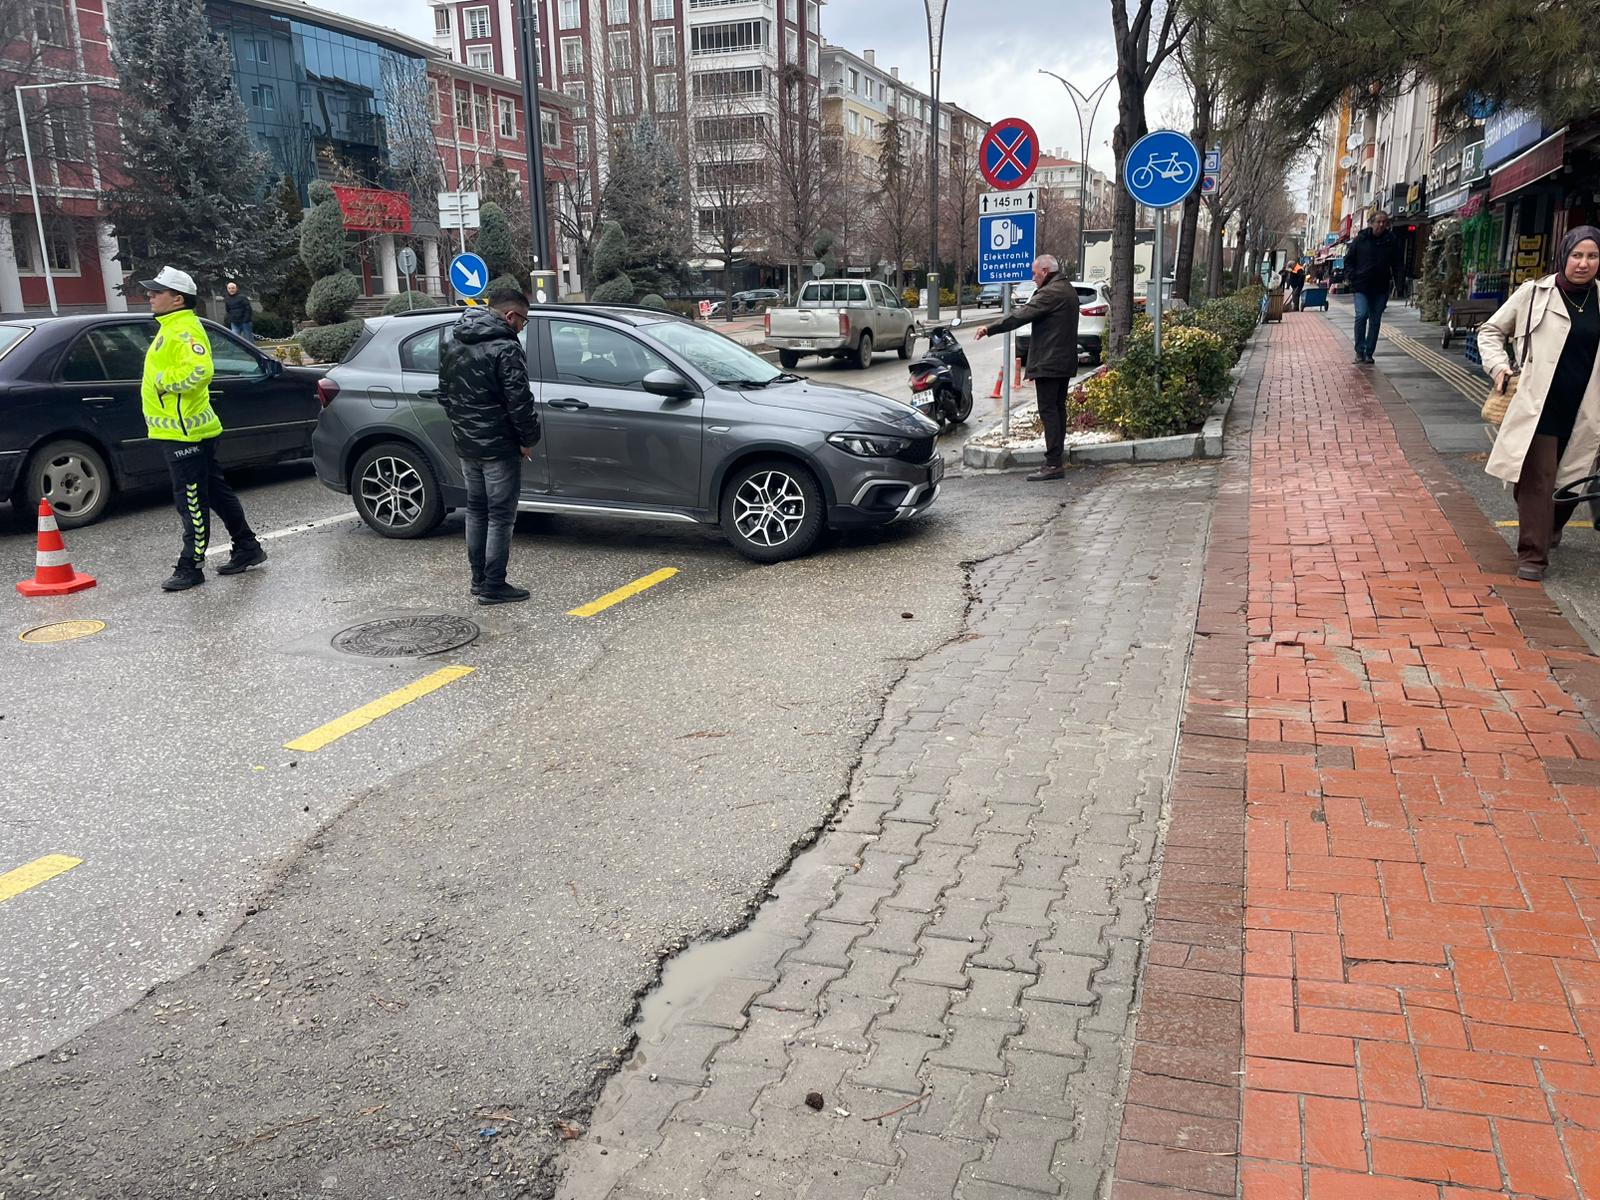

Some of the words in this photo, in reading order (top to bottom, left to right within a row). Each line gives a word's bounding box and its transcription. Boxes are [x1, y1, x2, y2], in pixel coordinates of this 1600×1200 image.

[994, 197, 1010, 208] 145
[1013, 197, 1022, 206] m
[983, 252, 1029, 261] Elektronik
[982, 262, 1030, 271] Denetleme
[990, 271, 1023, 279] Sistemi
